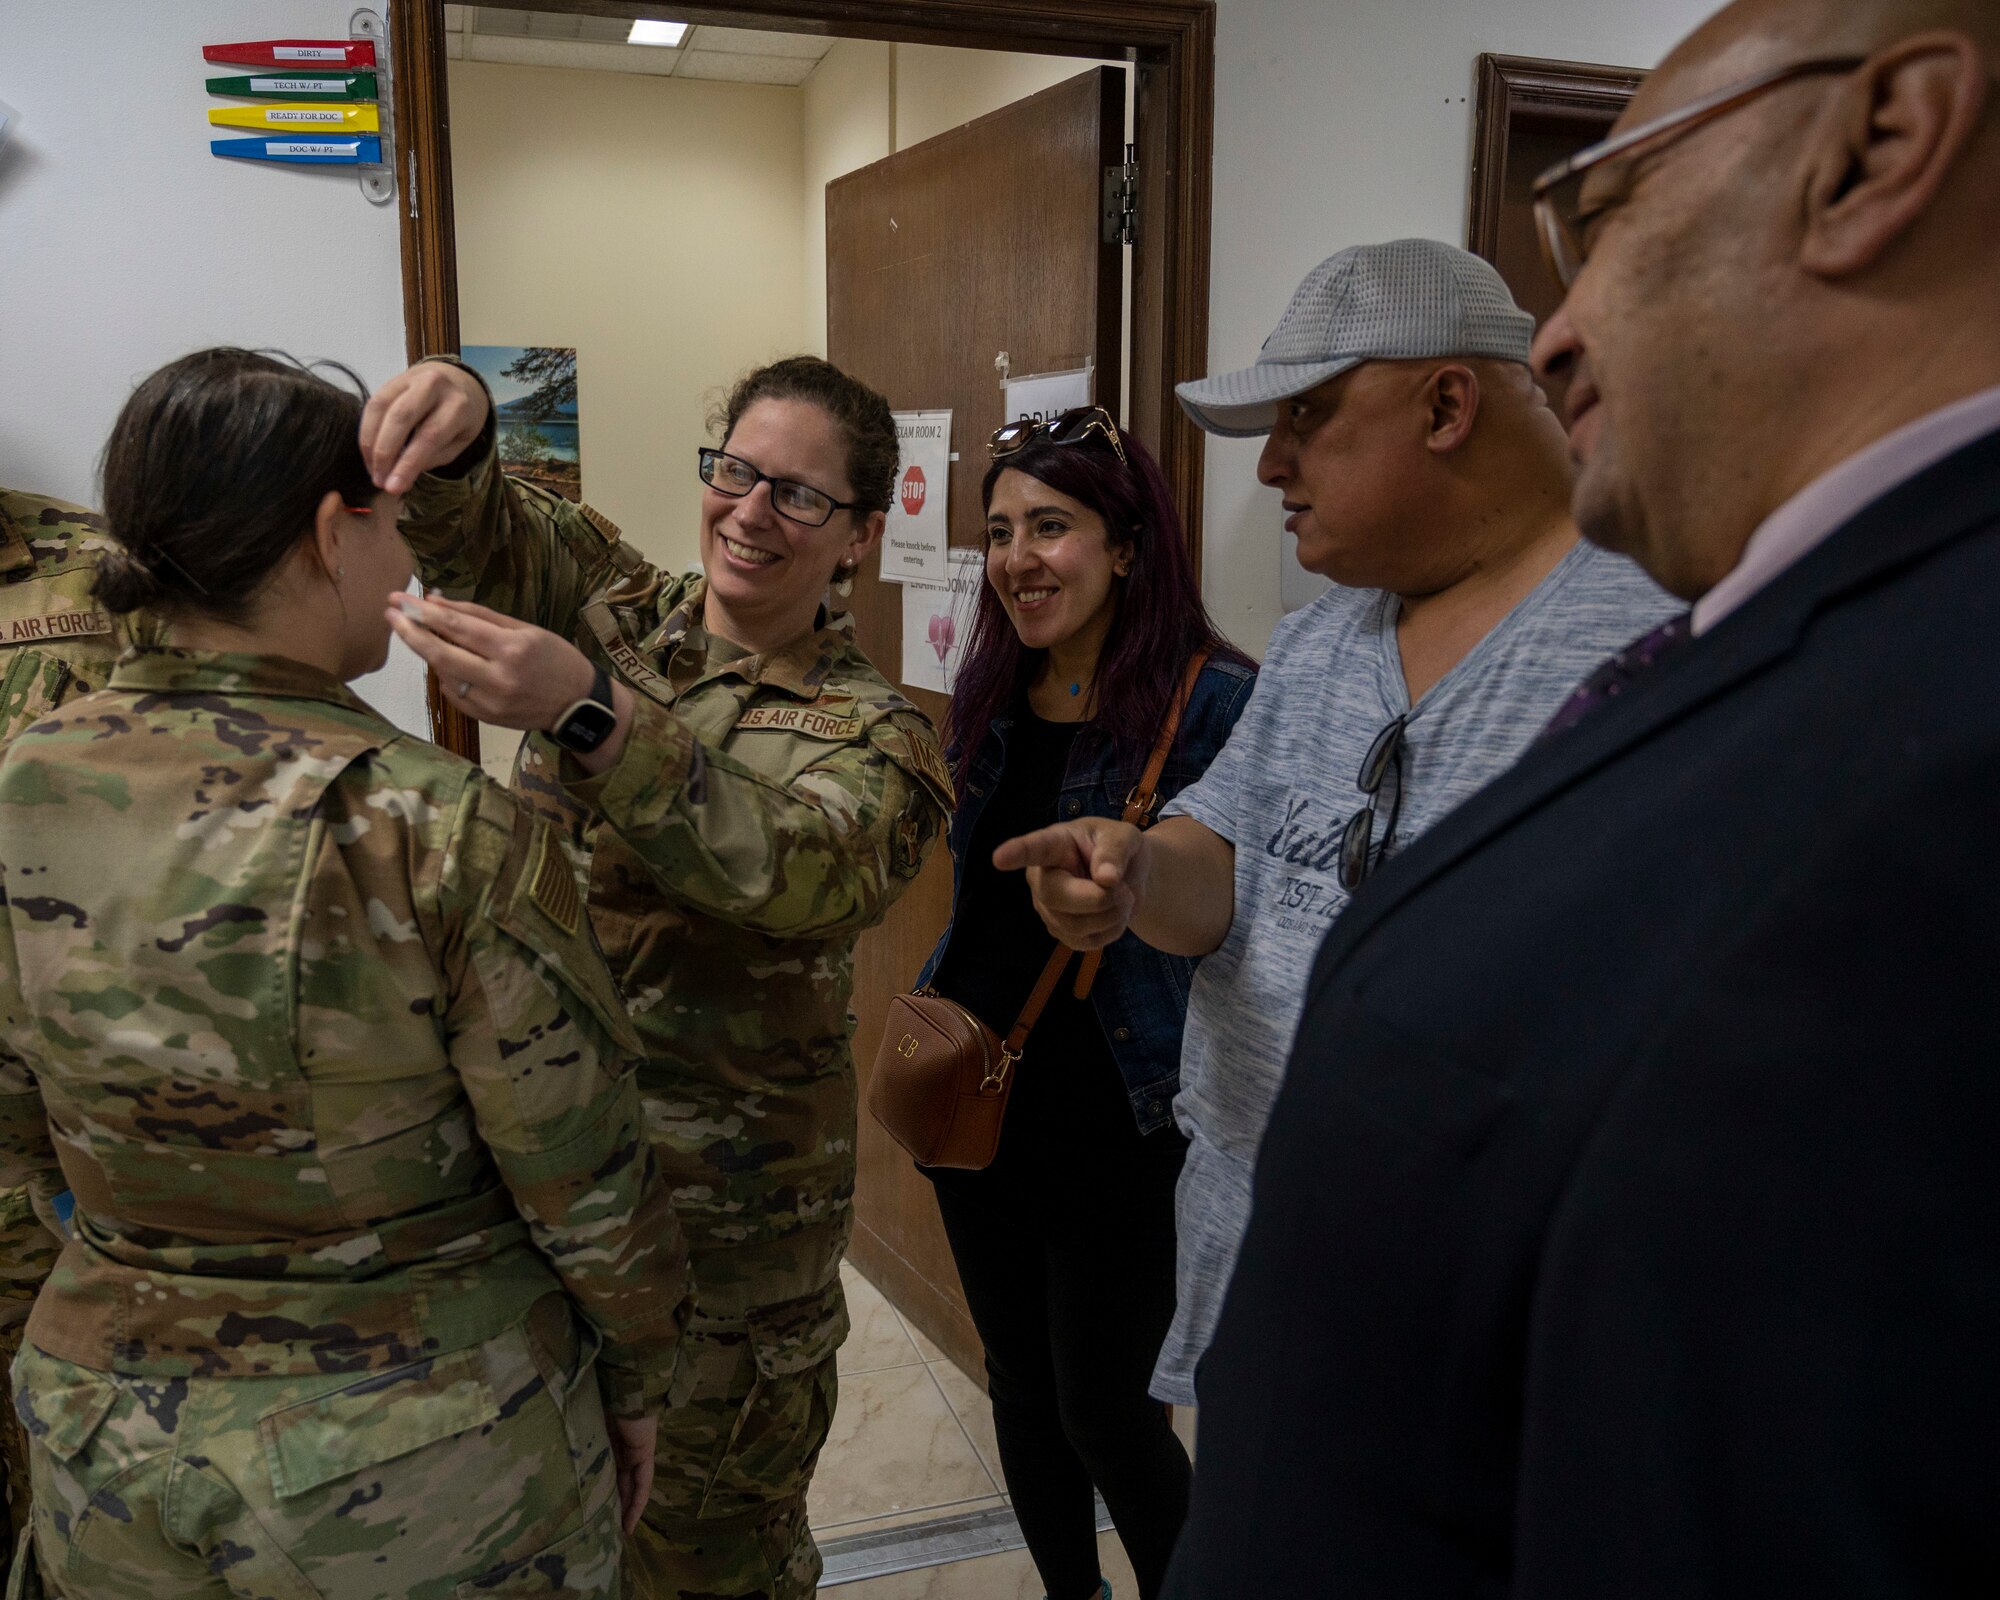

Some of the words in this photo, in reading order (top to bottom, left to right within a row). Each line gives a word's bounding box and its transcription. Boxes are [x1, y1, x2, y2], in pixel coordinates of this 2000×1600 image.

[297, 49, 322, 57] DIRTY
[273, 82, 297, 90] TECH
[299, 82, 310, 90] W/
[313, 82, 323, 90] PT
[270, 112, 299, 120] READY
[300, 112, 318, 120] FOR
[319, 112, 338, 121] DOC
[915, 425, 936, 438] ROOM
[936, 425, 941, 438] 2
[902, 481, 925, 499] STOP
[890, 538, 906, 549] Please
[906, 540, 921, 550] knock
[920, 541, 936, 553] before
[12, 618, 43, 639] AIR
[45, 612, 107, 635] FORCE
[605, 635, 659, 685] WERTZ
[768, 709, 798, 728] AIR
[800, 712, 860, 736] FORCE
[898, 1033, 919, 1058] CB
